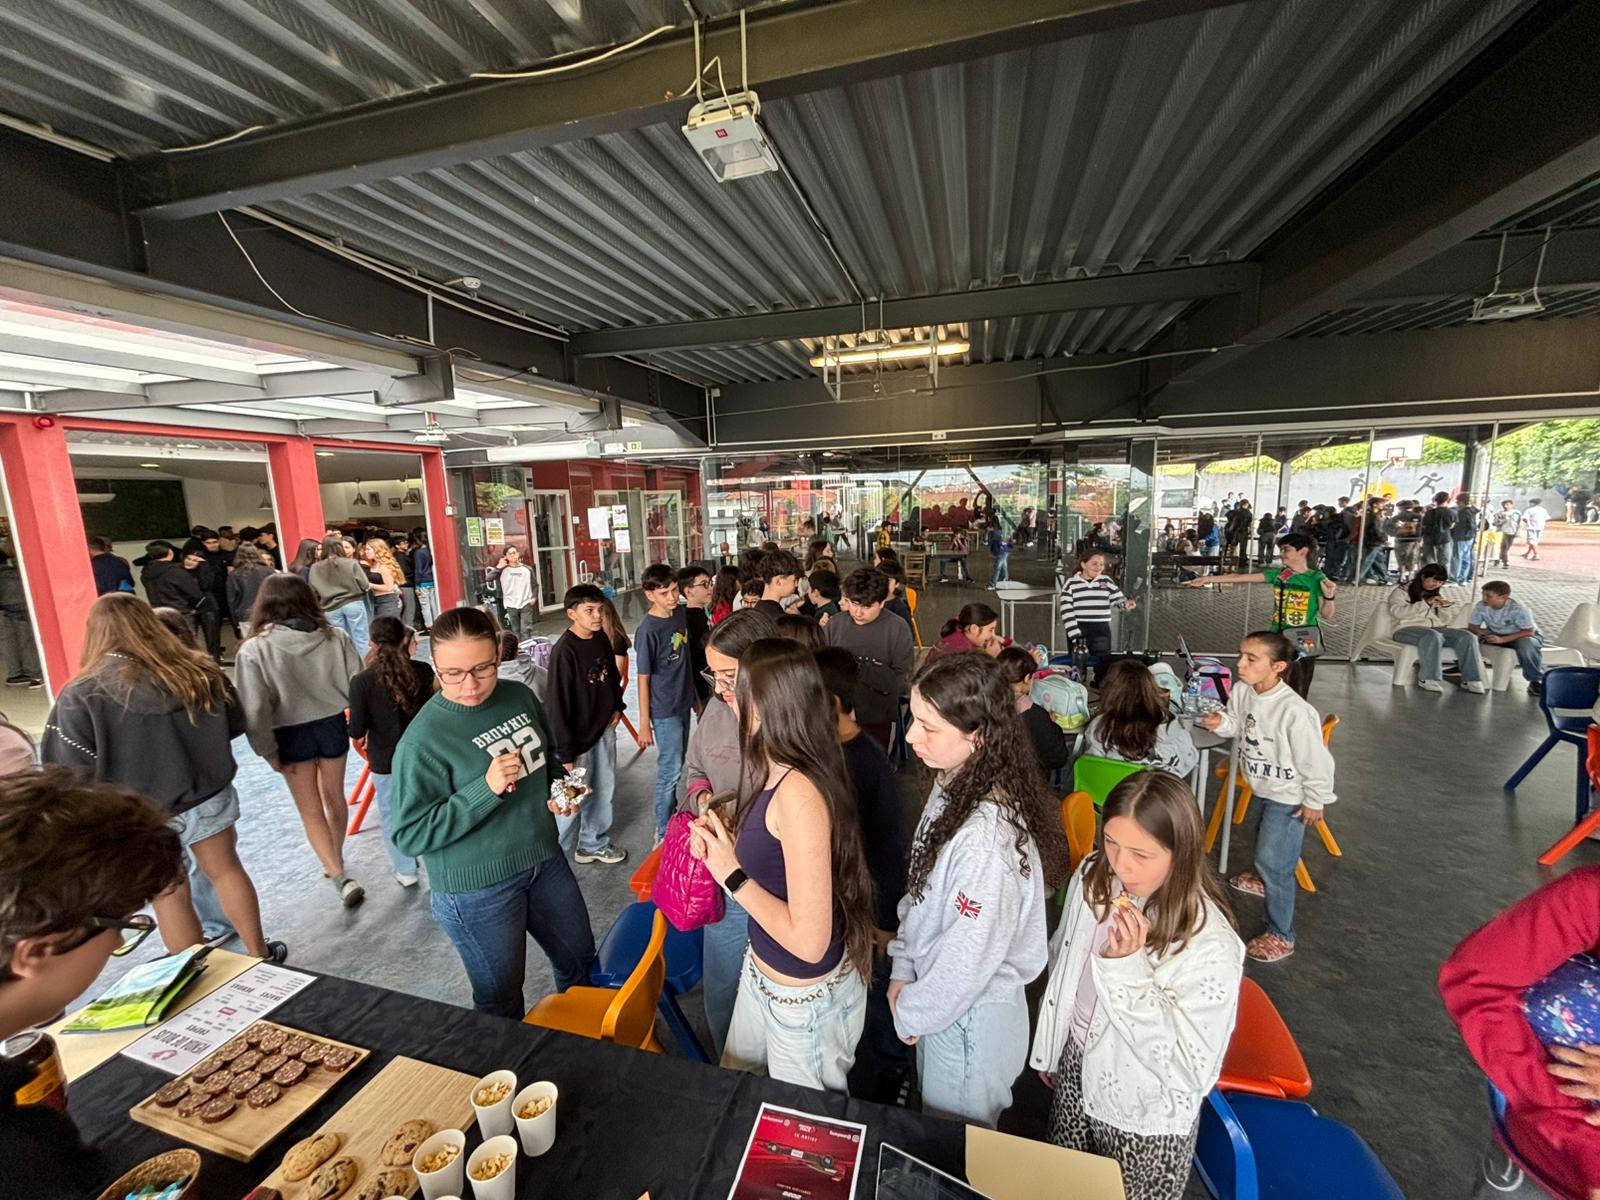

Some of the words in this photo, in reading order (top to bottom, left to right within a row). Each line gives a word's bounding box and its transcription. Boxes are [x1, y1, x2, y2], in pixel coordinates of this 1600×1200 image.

[472, 713, 531, 749] BROWNIE
[185, 1024, 210, 1036] CREPES
[170, 1035, 190, 1047] DE
